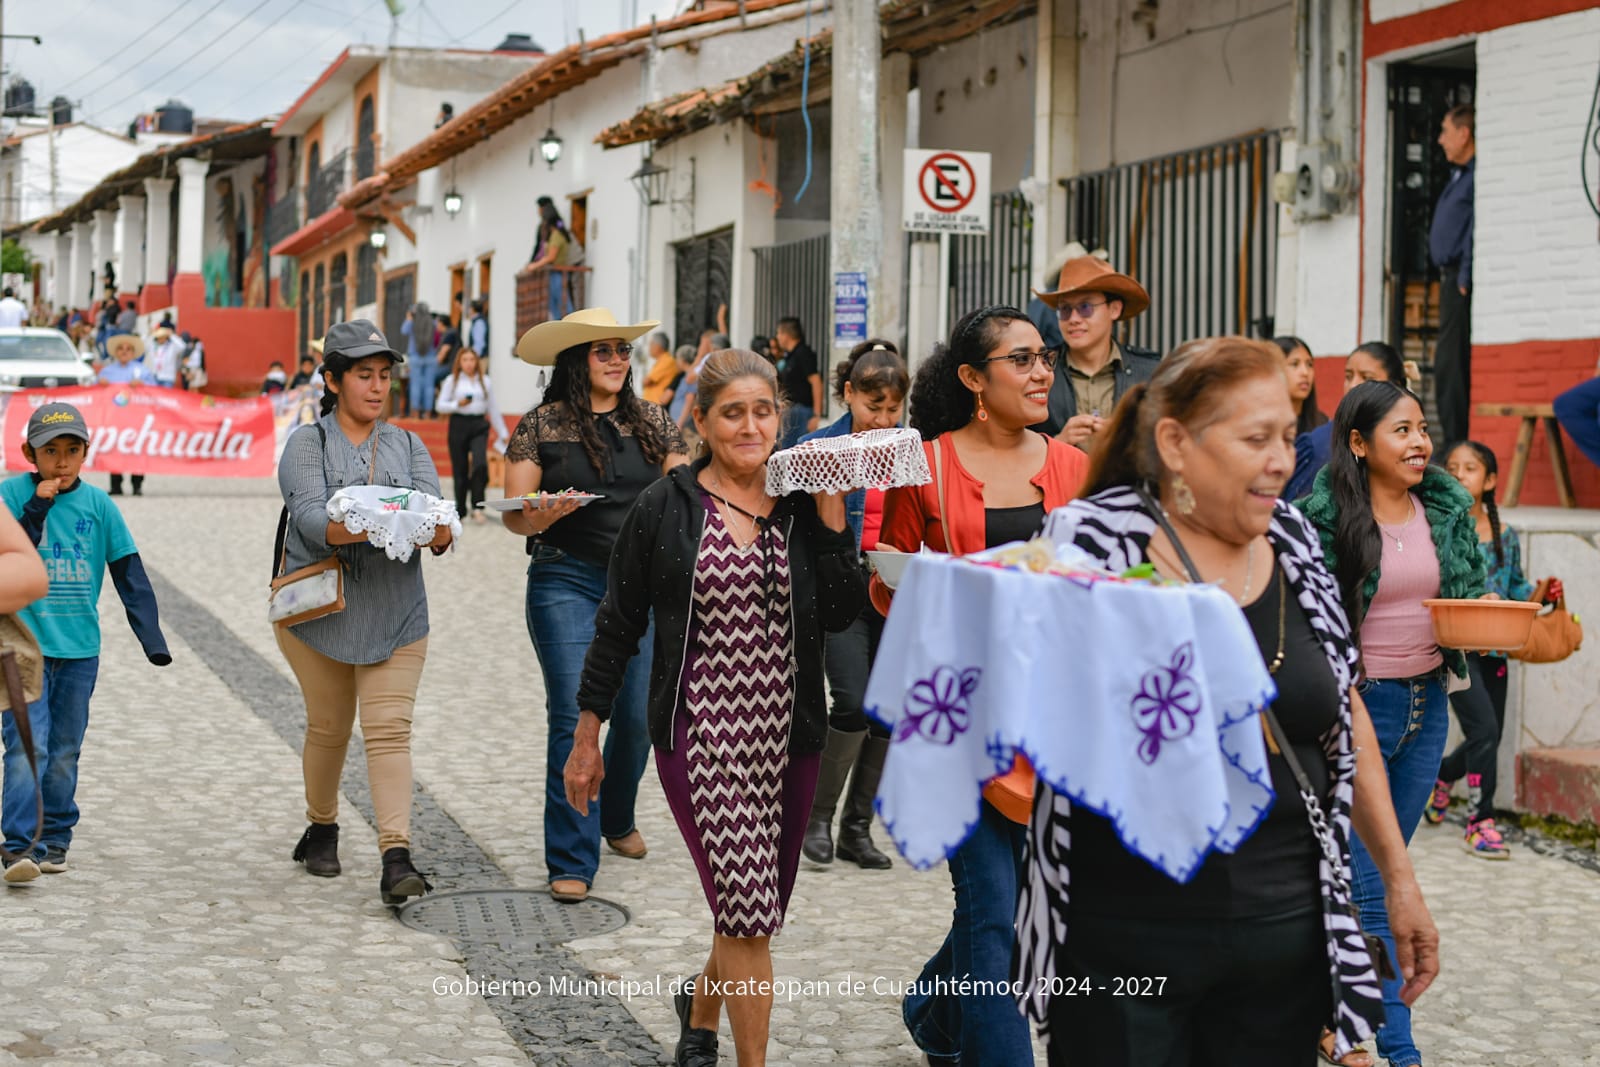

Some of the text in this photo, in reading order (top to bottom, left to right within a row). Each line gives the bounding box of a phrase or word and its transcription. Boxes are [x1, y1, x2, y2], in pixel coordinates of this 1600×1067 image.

[836, 285, 867, 298] REPA
[21, 414, 253, 467] pehuala
[75, 519, 92, 534] #7
